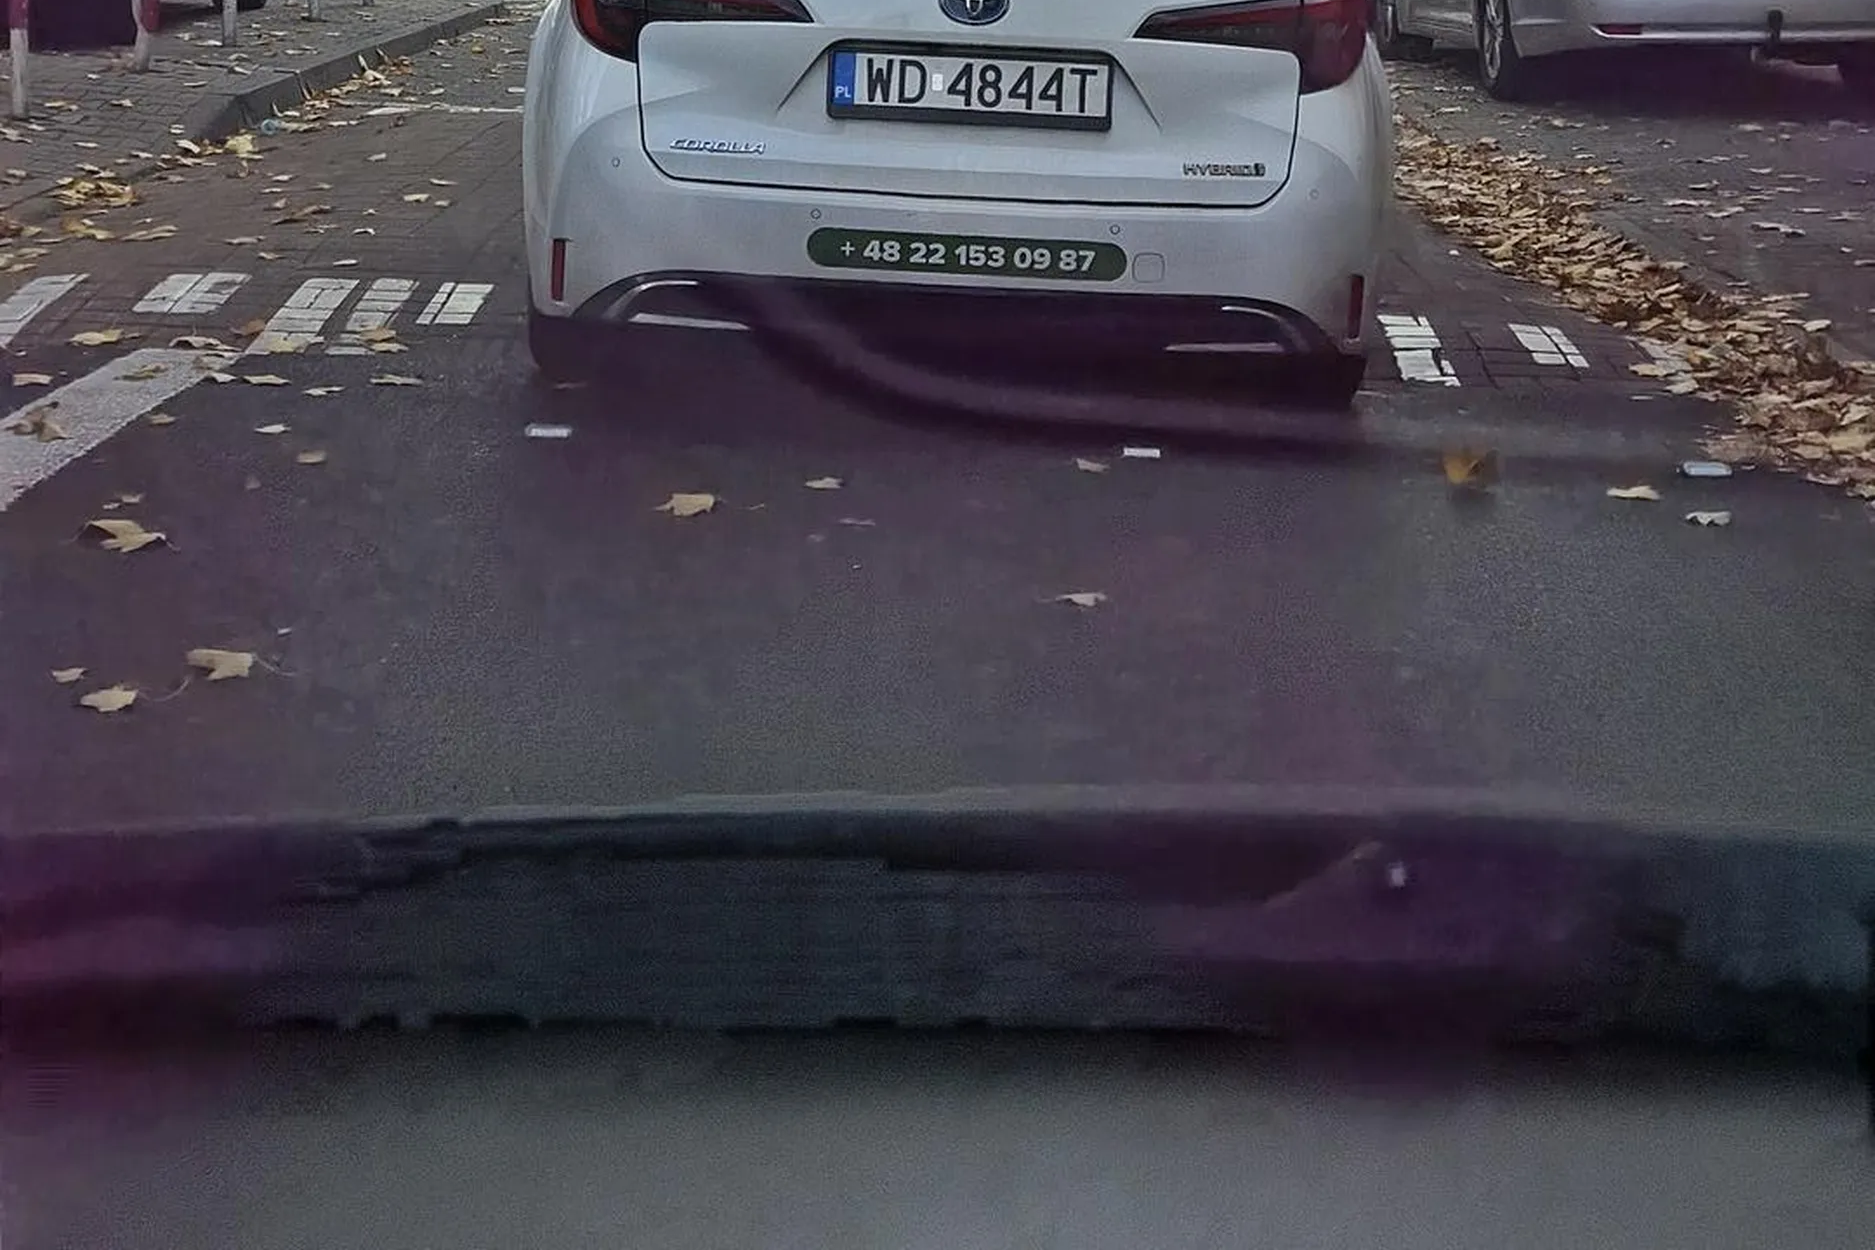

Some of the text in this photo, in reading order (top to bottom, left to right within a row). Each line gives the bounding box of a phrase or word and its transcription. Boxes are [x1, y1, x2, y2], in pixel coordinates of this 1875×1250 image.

[835, 85, 851, 99] PL
[867, 57, 1098, 113] WD 4844T
[669, 138, 766, 154] COROLLA
[1183, 163, 1254, 177] HYBRID
[863, 240, 901, 261] 48
[909, 243, 946, 265] 22
[955, 245, 1005, 268] 153
[1014, 247, 1051, 270] 09
[1059, 249, 1096, 273] 87
